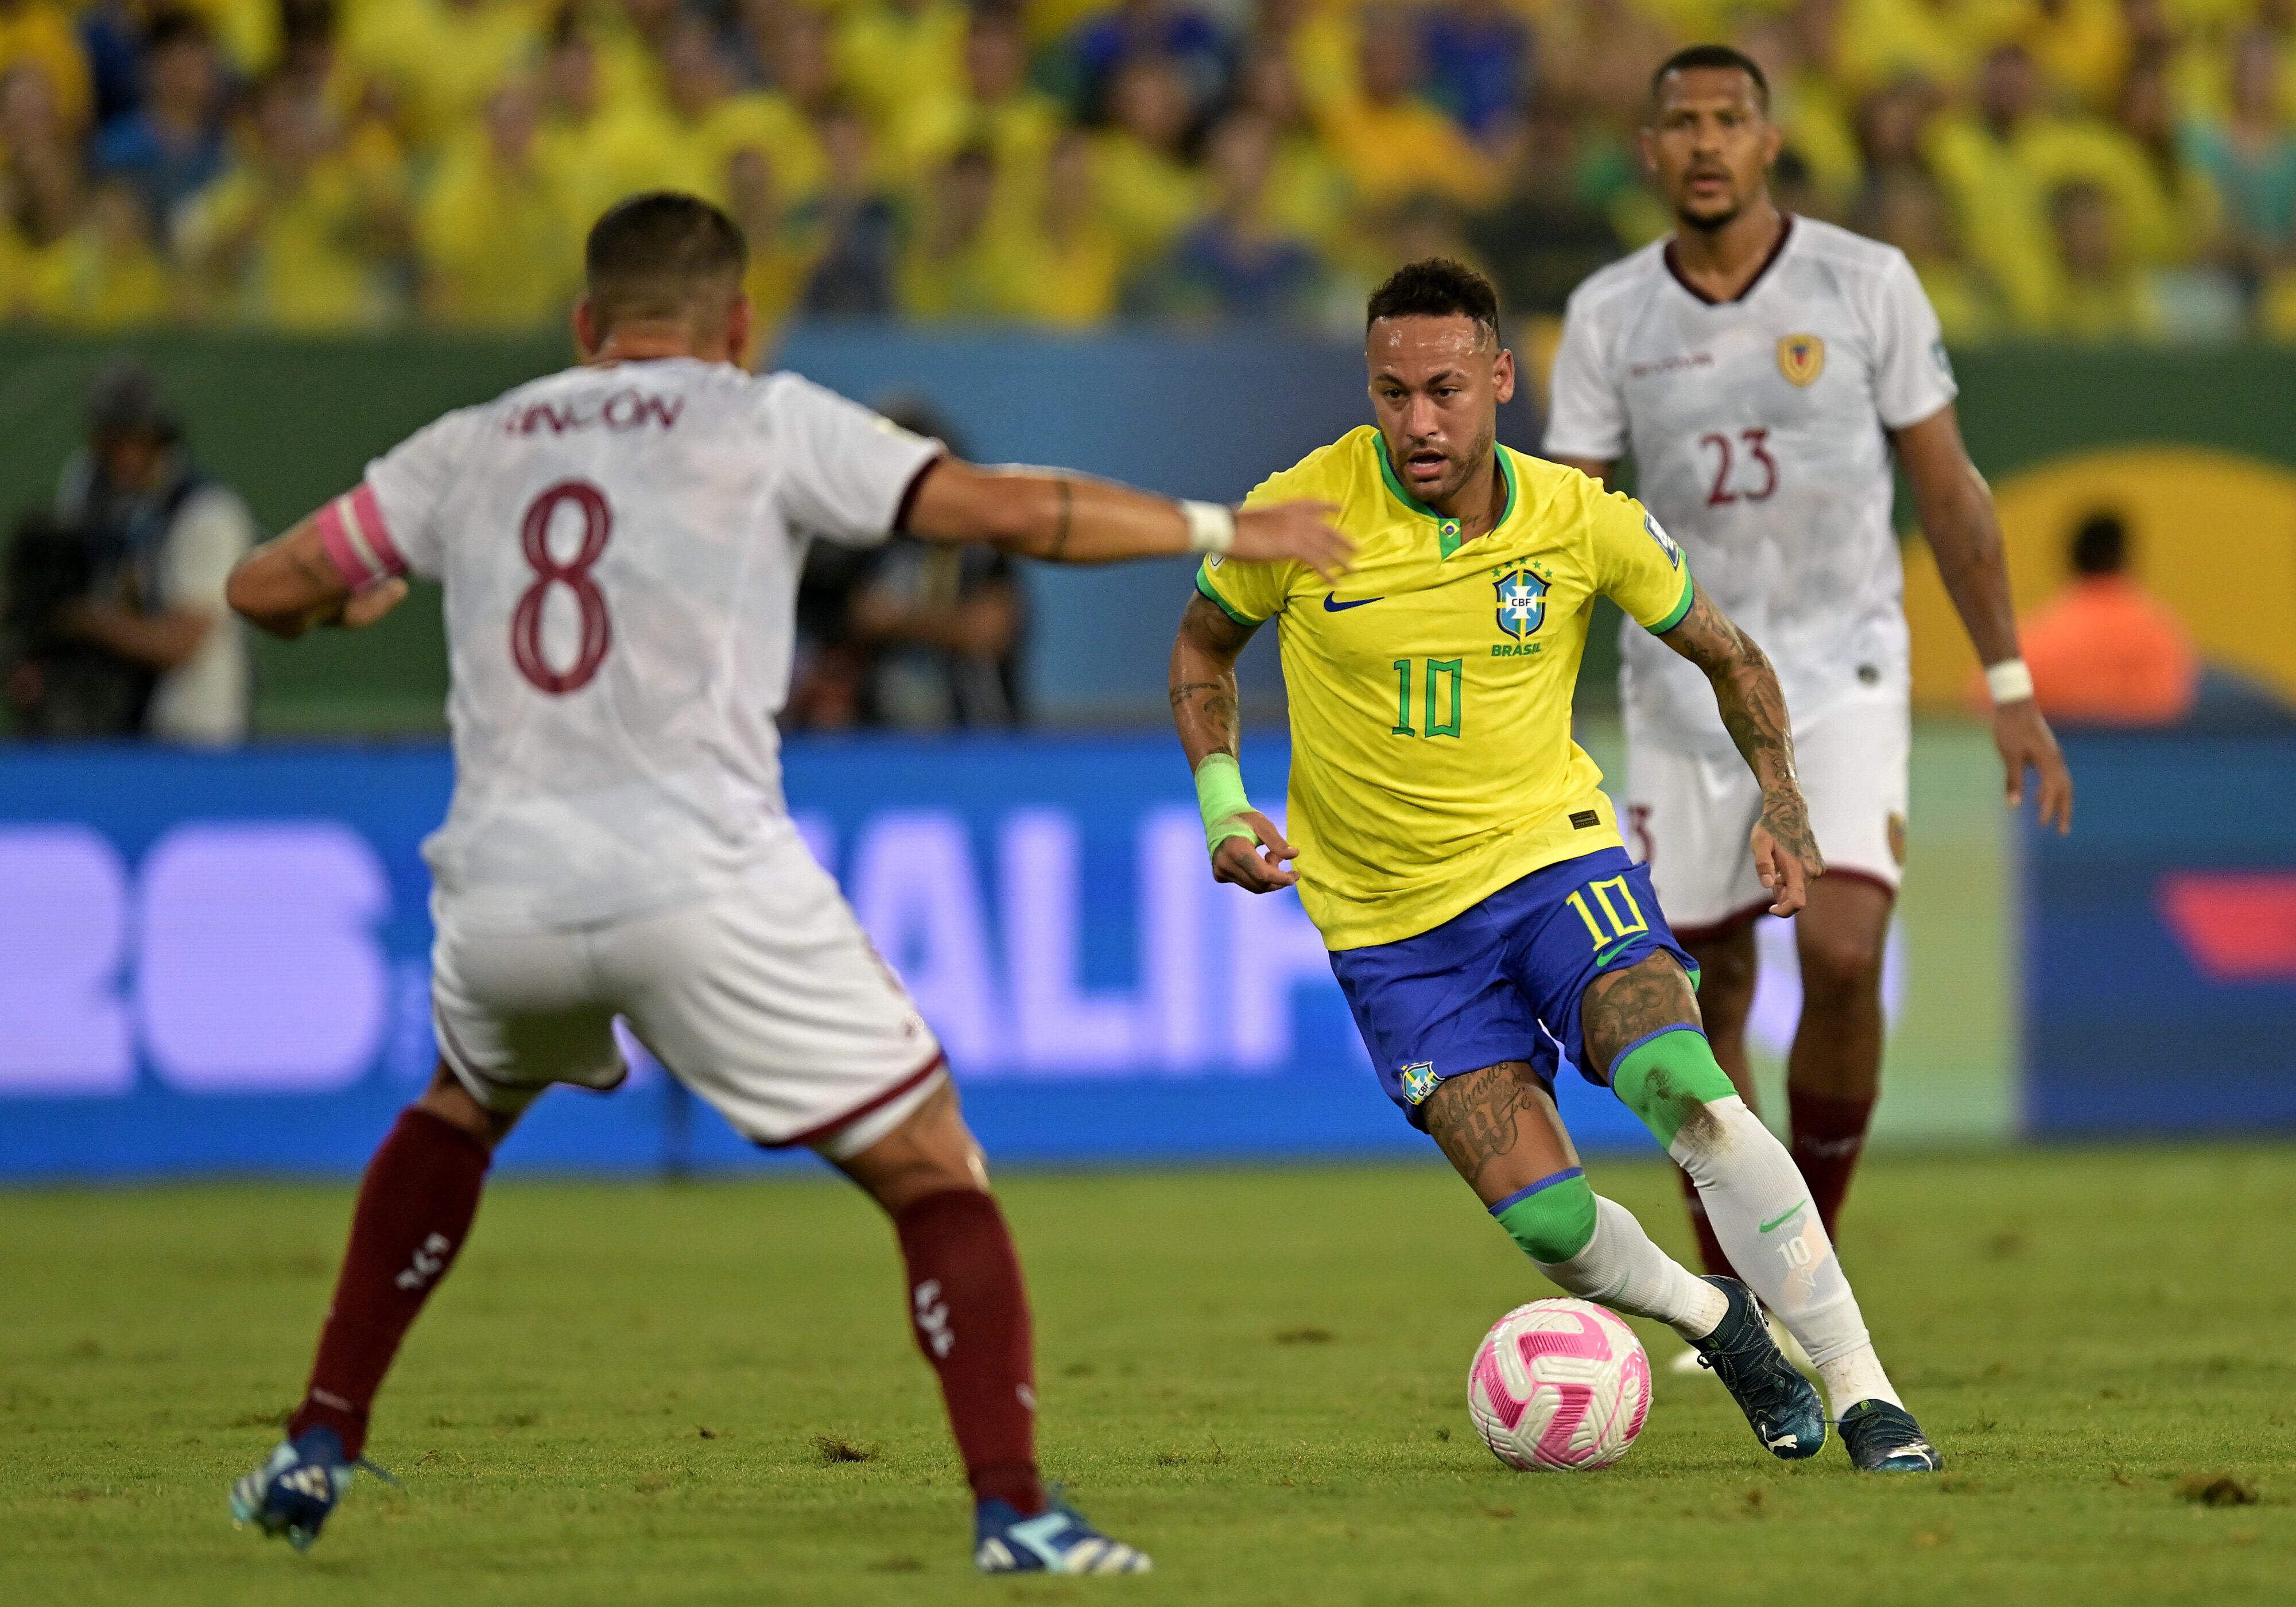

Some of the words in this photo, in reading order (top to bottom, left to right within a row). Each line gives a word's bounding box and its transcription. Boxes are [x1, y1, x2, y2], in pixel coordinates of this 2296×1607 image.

[1698, 427, 1781, 509] 23
[511, 476, 613, 696] 8
[1511, 598, 1531, 607] CBF
[1491, 642, 1542, 657] BRASIL
[1392, 658, 1463, 739] 10
[1565, 874, 1650, 952] 10
[1417, 1082, 1430, 1097] CBF
[1777, 1236, 1812, 1270] 10
